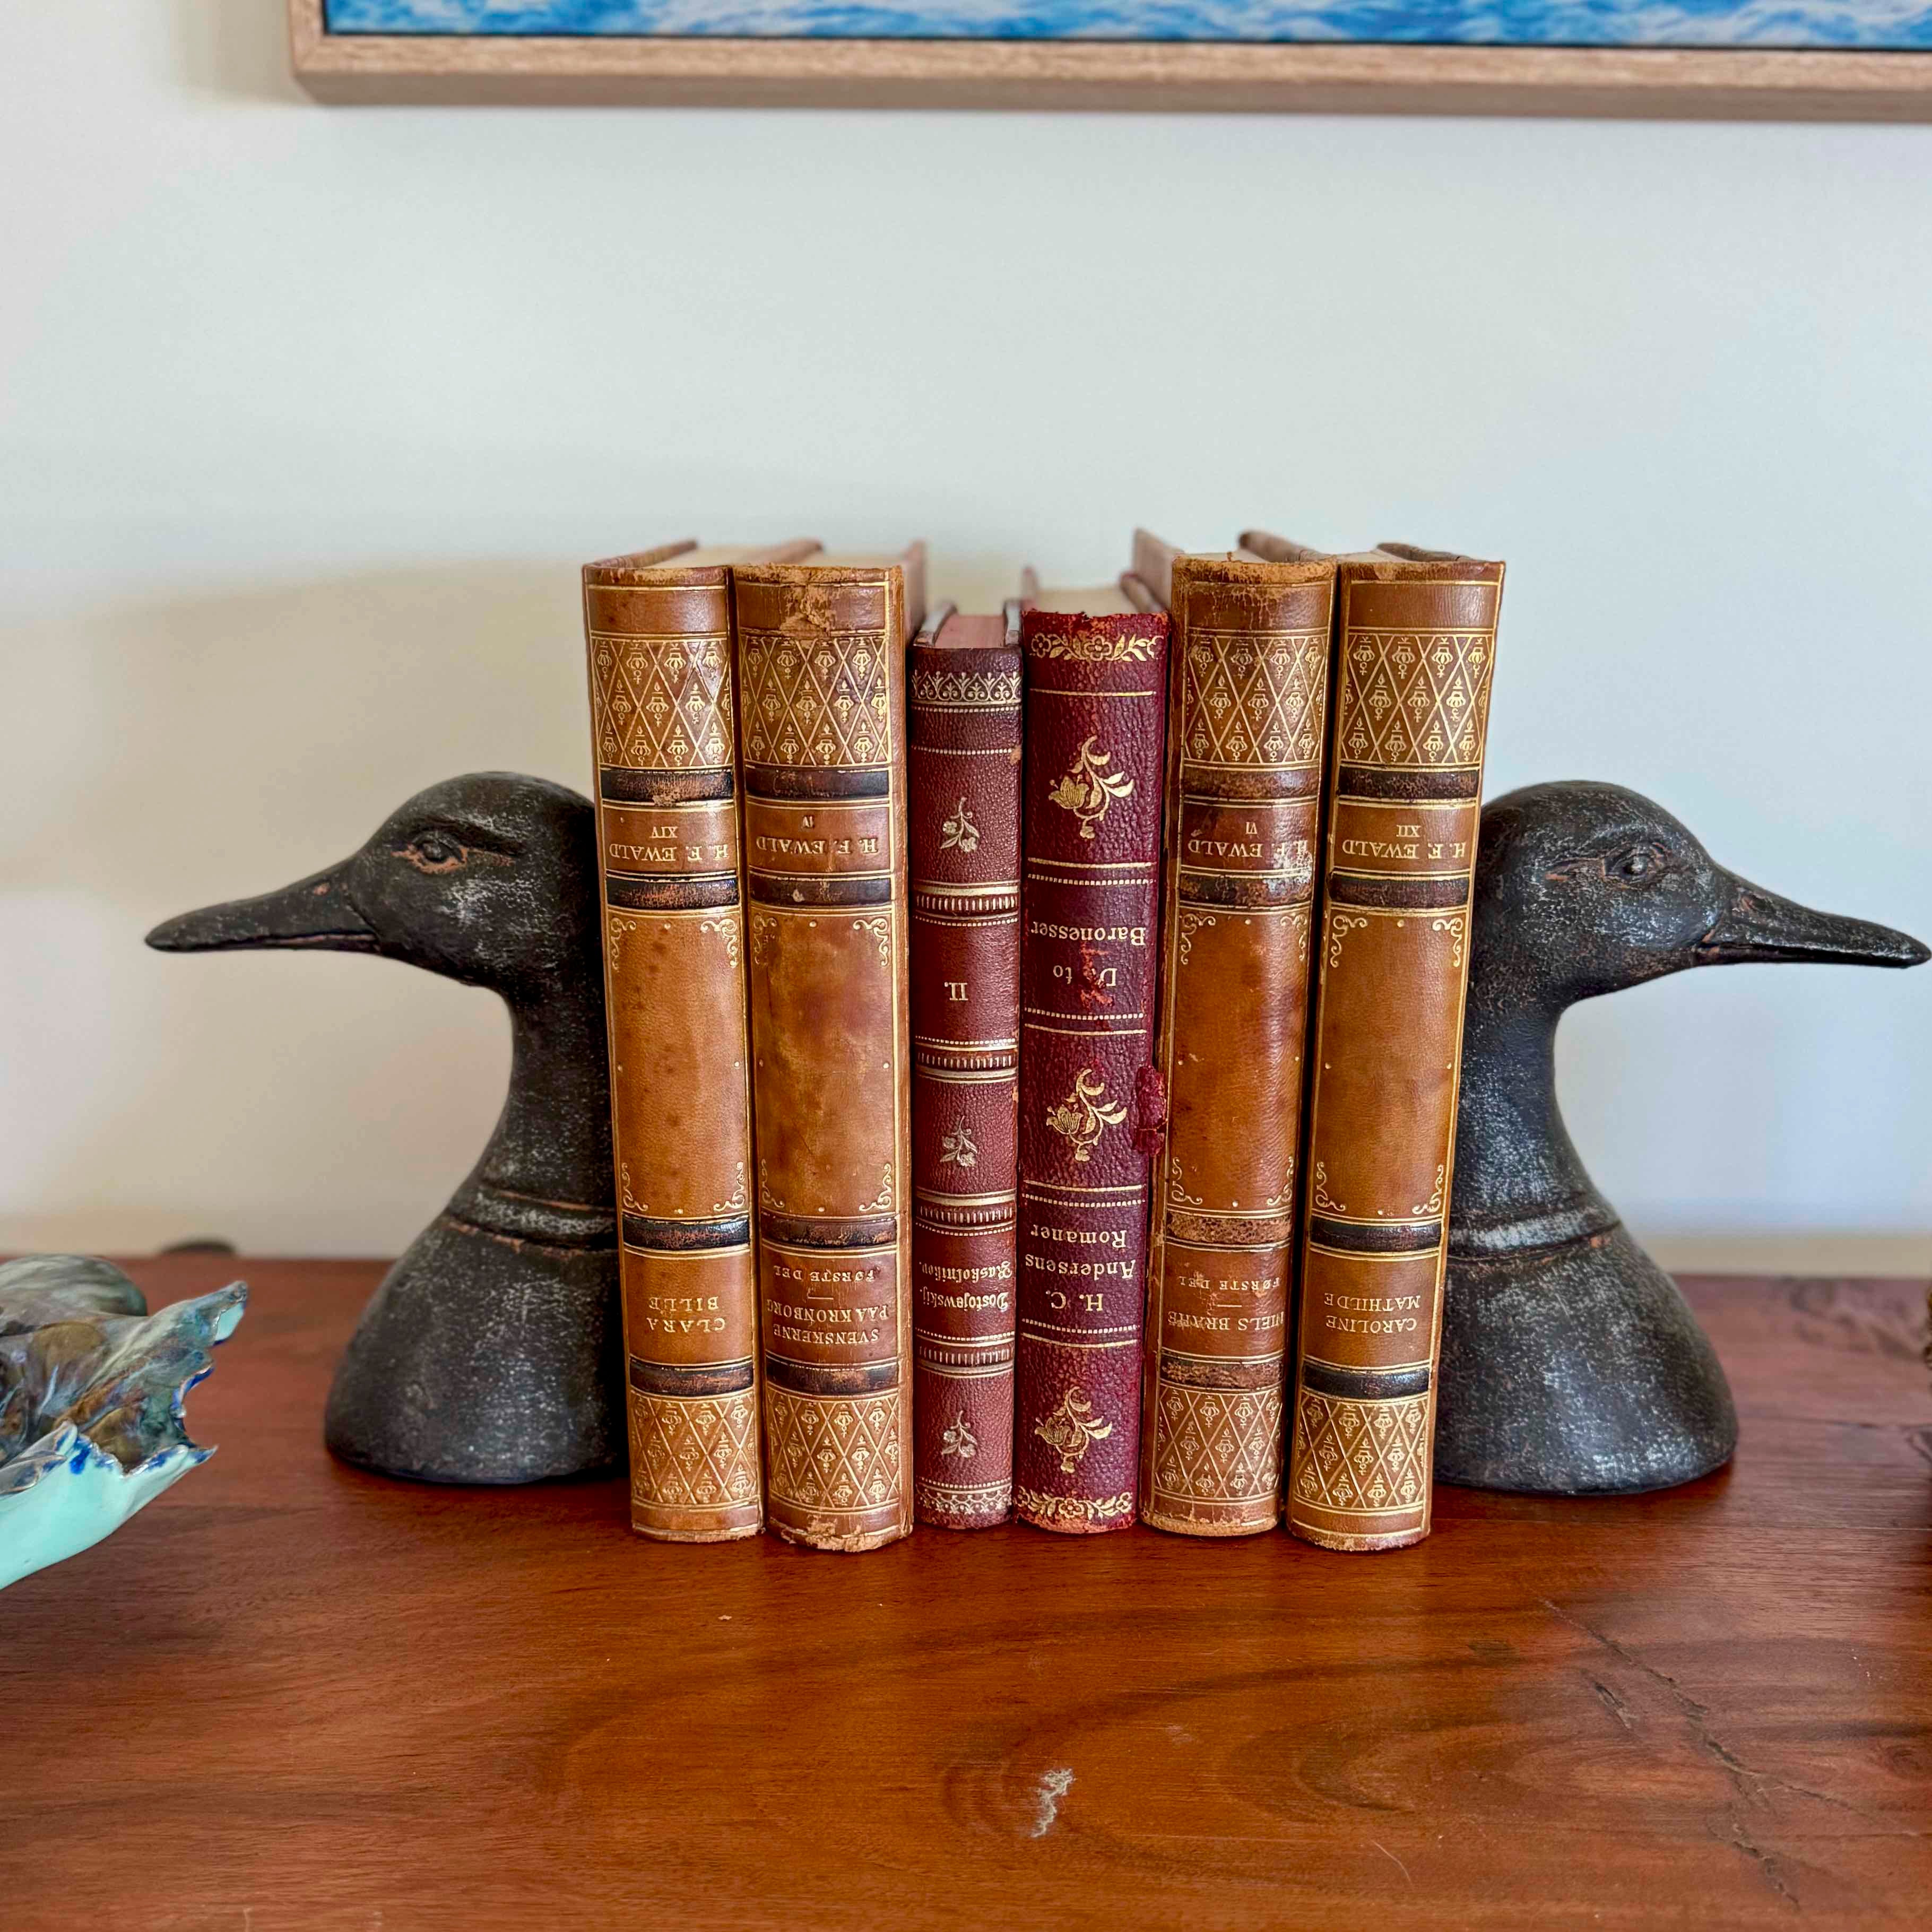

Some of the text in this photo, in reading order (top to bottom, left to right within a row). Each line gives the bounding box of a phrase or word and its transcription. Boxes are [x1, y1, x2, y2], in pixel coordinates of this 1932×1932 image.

[802, 816, 815, 828] IV
[1244, 821, 1258, 835] VI
[1396, 824, 1422, 837] XII
[649, 826, 678, 838] XIV
[609, 843, 730, 862] H. F. EWALD
[756, 836, 878, 854] H. F. EWALD
[1187, 839, 1263, 858] EWALD
[1342, 839, 1467, 859] H. F. EWALD
[1030, 921, 1147, 946] Baronesser
[1052, 965, 1117, 987] D to
[944, 982, 968, 1001] II.
[1030, 1224, 1128, 1249] Romaner
[773, 1265, 877, 1283] FØRSTE DEL
[919, 1260, 1013, 1283] Raskolnikov.
[1024, 1253, 1137, 1281] Andersens
[1179, 1275, 1280, 1291] FØRSTE DEL
[648, 1296, 719, 1312] BILLE
[919, 1286, 1009, 1313] Dostojewskij.
[1045, 1290, 1104, 1312] H. C.
[1323, 1292, 1422, 1312] MATHILDE
[766, 1298, 889, 1323] PAA KRONBORG
[646, 1317, 726, 1333] CLARA
[1167, 1311, 1285, 1331] NIELS BRAHE
[1325, 1315, 1417, 1334] CAROLINE
[773, 1323, 880, 1345] SVENSKERNE
